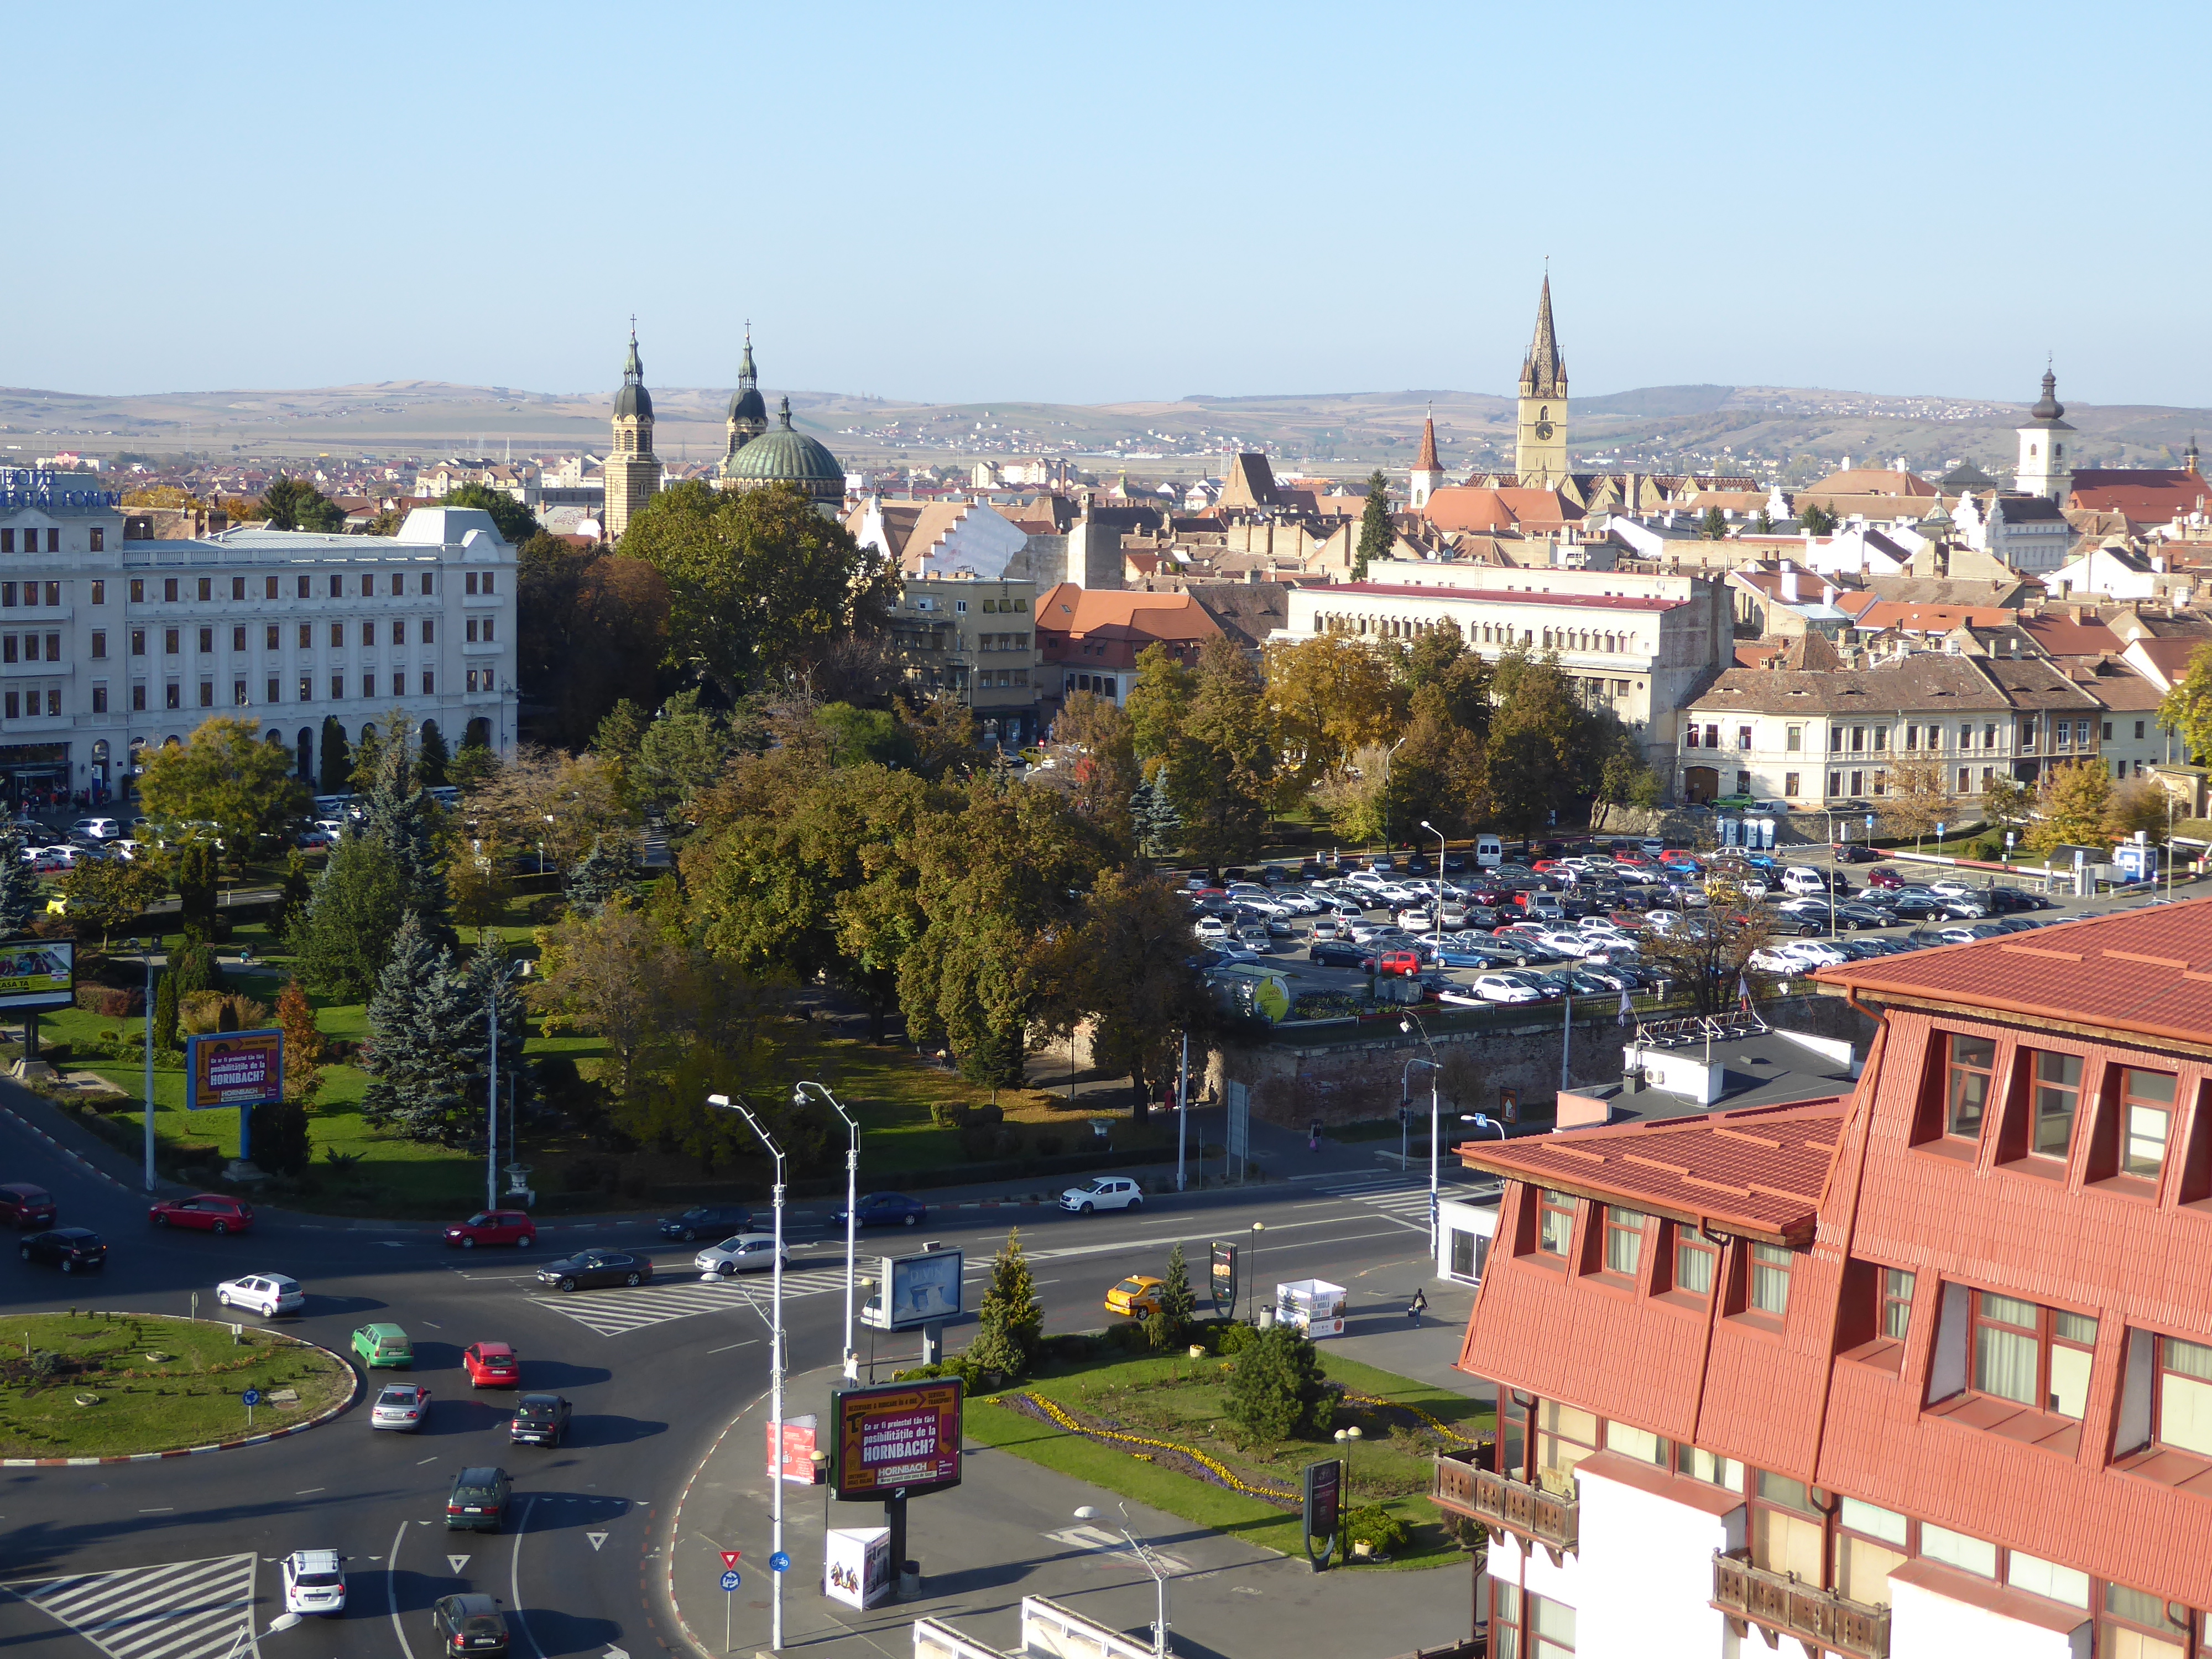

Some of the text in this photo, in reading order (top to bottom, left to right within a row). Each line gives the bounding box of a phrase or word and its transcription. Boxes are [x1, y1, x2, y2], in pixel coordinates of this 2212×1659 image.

[2, 469, 60, 485] HOTEL
[62, 490, 121, 507] FORUM
[211, 1070, 264, 1086] HORNBACH?
[222, 1088, 258, 1096] HORNBACH
[888, 1419, 912, 1430] proiectul
[864, 1425, 936, 1446] posibilitățile de la
[863, 1438, 935, 1462] HORNBACH?
[878, 1462, 927, 1477] HORNBACH
